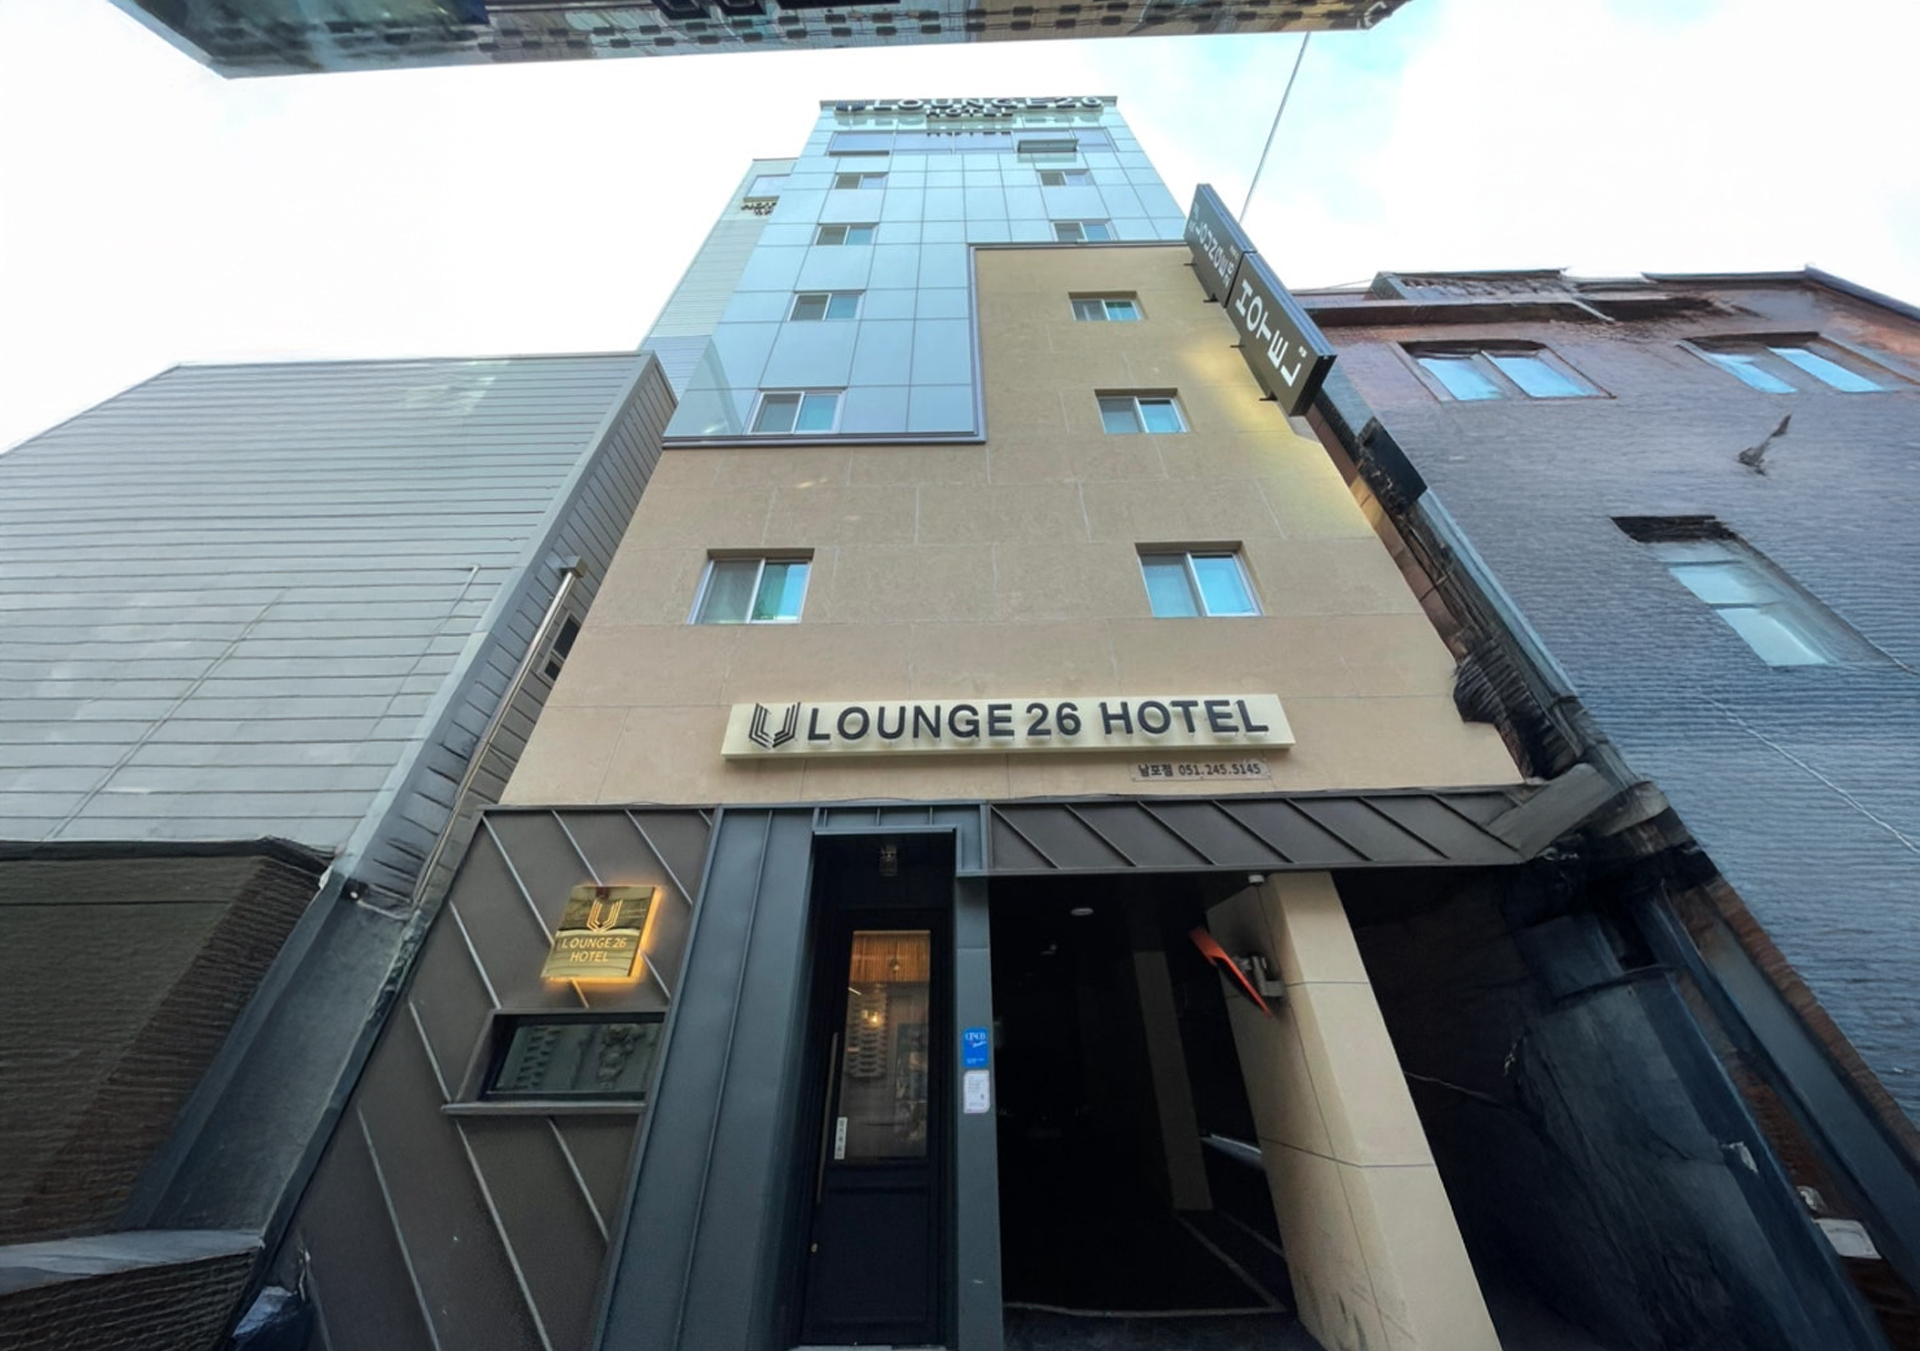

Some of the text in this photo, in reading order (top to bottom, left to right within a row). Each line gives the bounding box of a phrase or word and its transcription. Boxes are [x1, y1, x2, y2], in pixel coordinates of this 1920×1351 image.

[1235, 279, 1301, 387] HOTEL
[807, 699, 1270, 741] LOUNGE 26 HOTEL
[1138, 763, 1261, 777] 남포점 051.245.5145
[562, 937, 627, 949] LOUNGE 26
[570, 951, 609, 962] HOTEL
